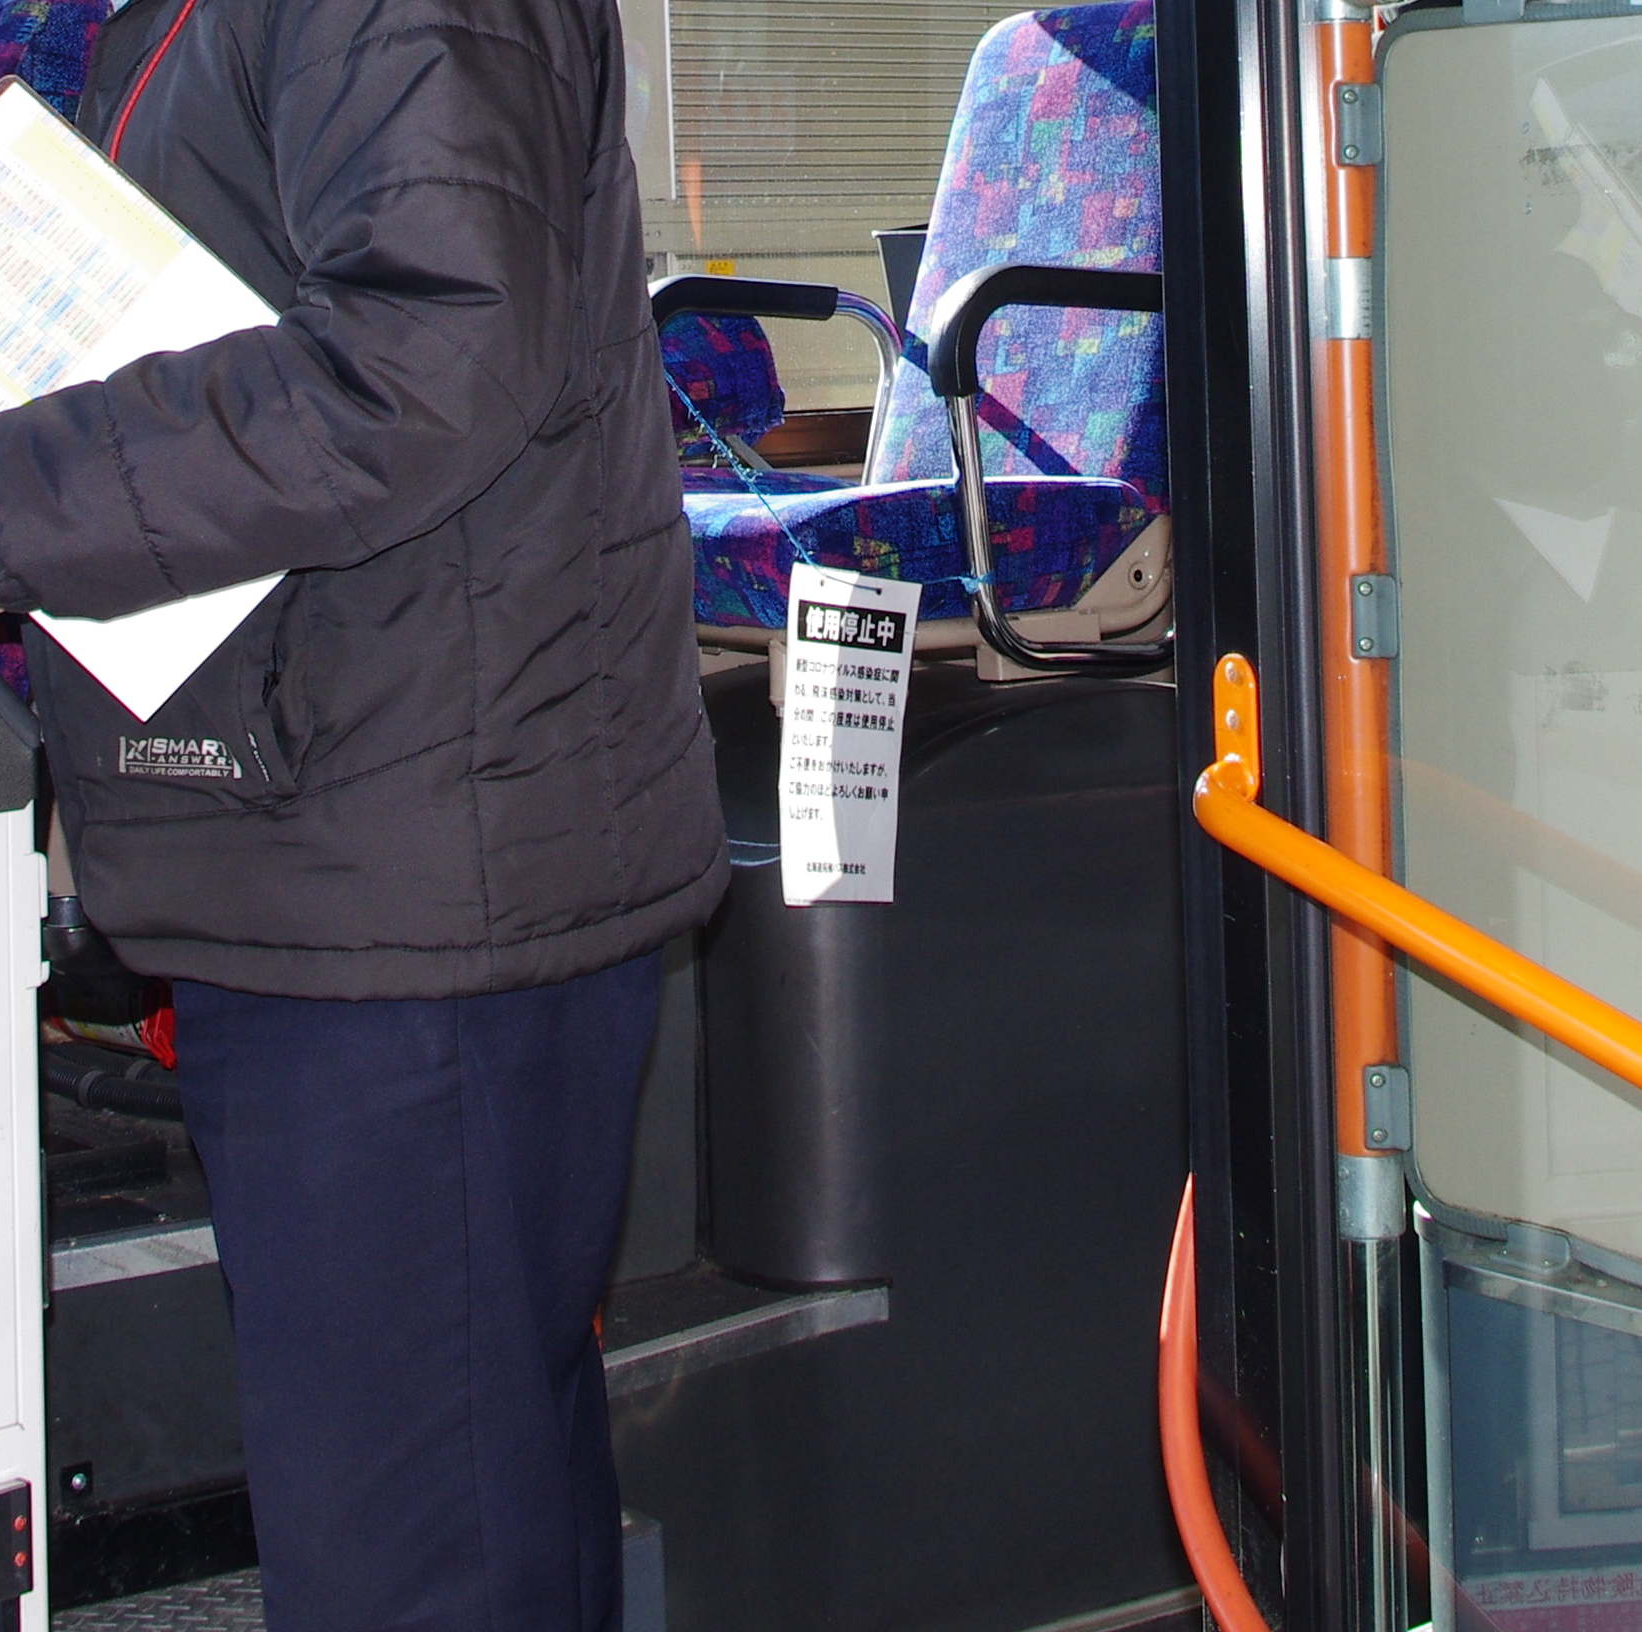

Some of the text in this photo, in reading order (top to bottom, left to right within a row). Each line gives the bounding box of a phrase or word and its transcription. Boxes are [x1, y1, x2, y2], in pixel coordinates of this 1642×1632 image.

[805, 605, 896, 648] 使用停止中
[129, 766, 230, 778] DAILY LIFE COMFORTABLY
[789, 781, 889, 802] ご協力のほどよろしくお願い申
